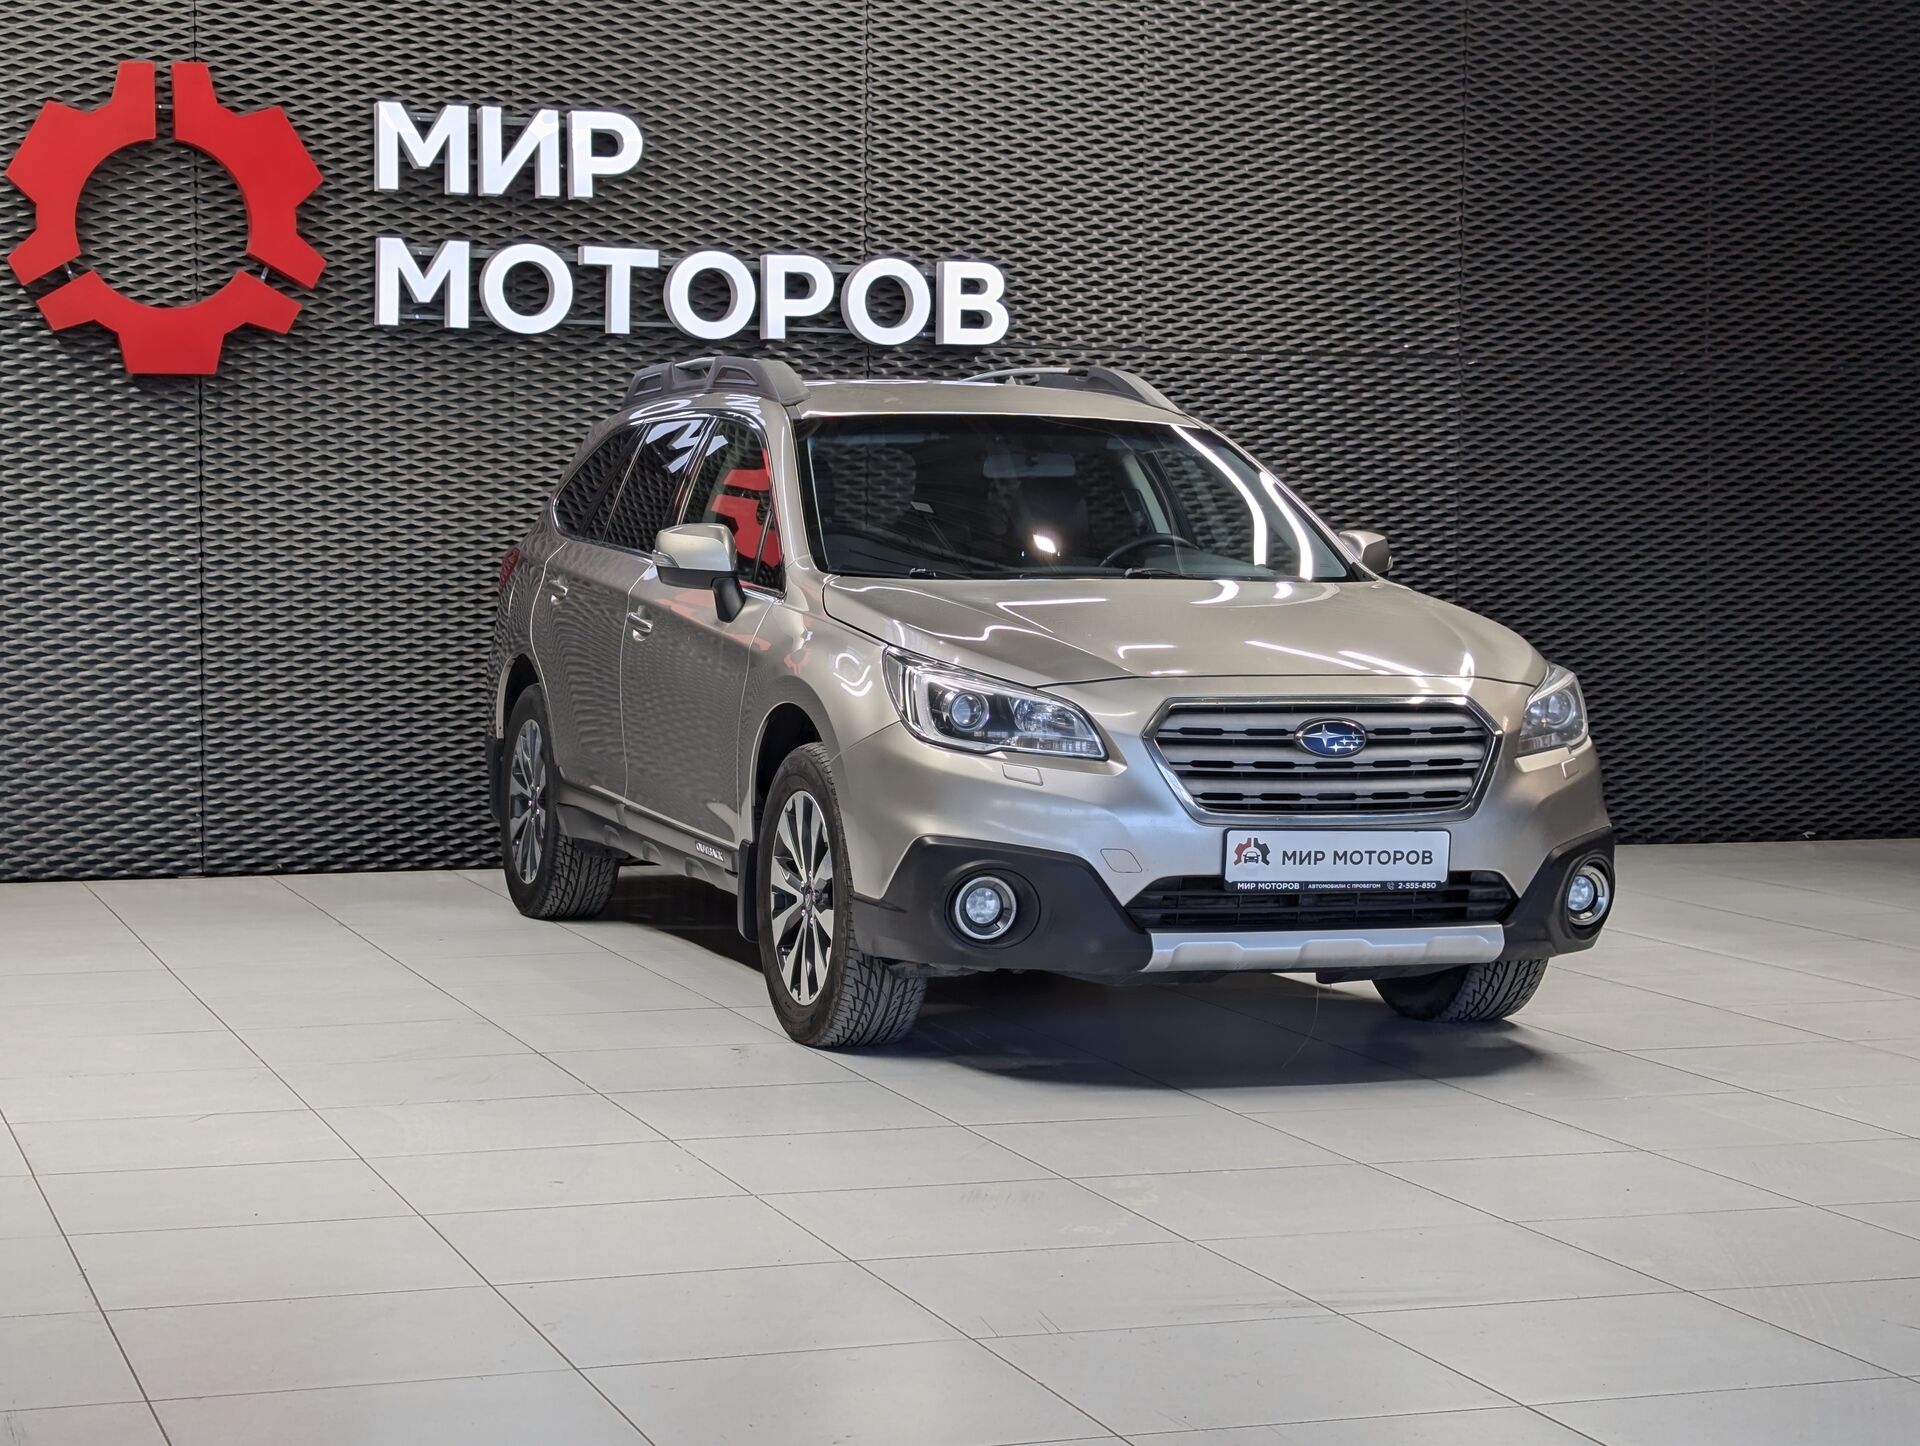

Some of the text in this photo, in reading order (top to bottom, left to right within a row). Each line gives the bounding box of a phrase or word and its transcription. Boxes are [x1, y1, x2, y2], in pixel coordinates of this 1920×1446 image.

[373, 101, 644, 199] МИР
[374, 237, 1010, 346] МОТОРОВ
[1281, 850, 1433, 865] МИР МОТОРОВ
[1237, 882, 1256, 890] МИР
[1258, 882, 1300, 890] МОТОРОВ
